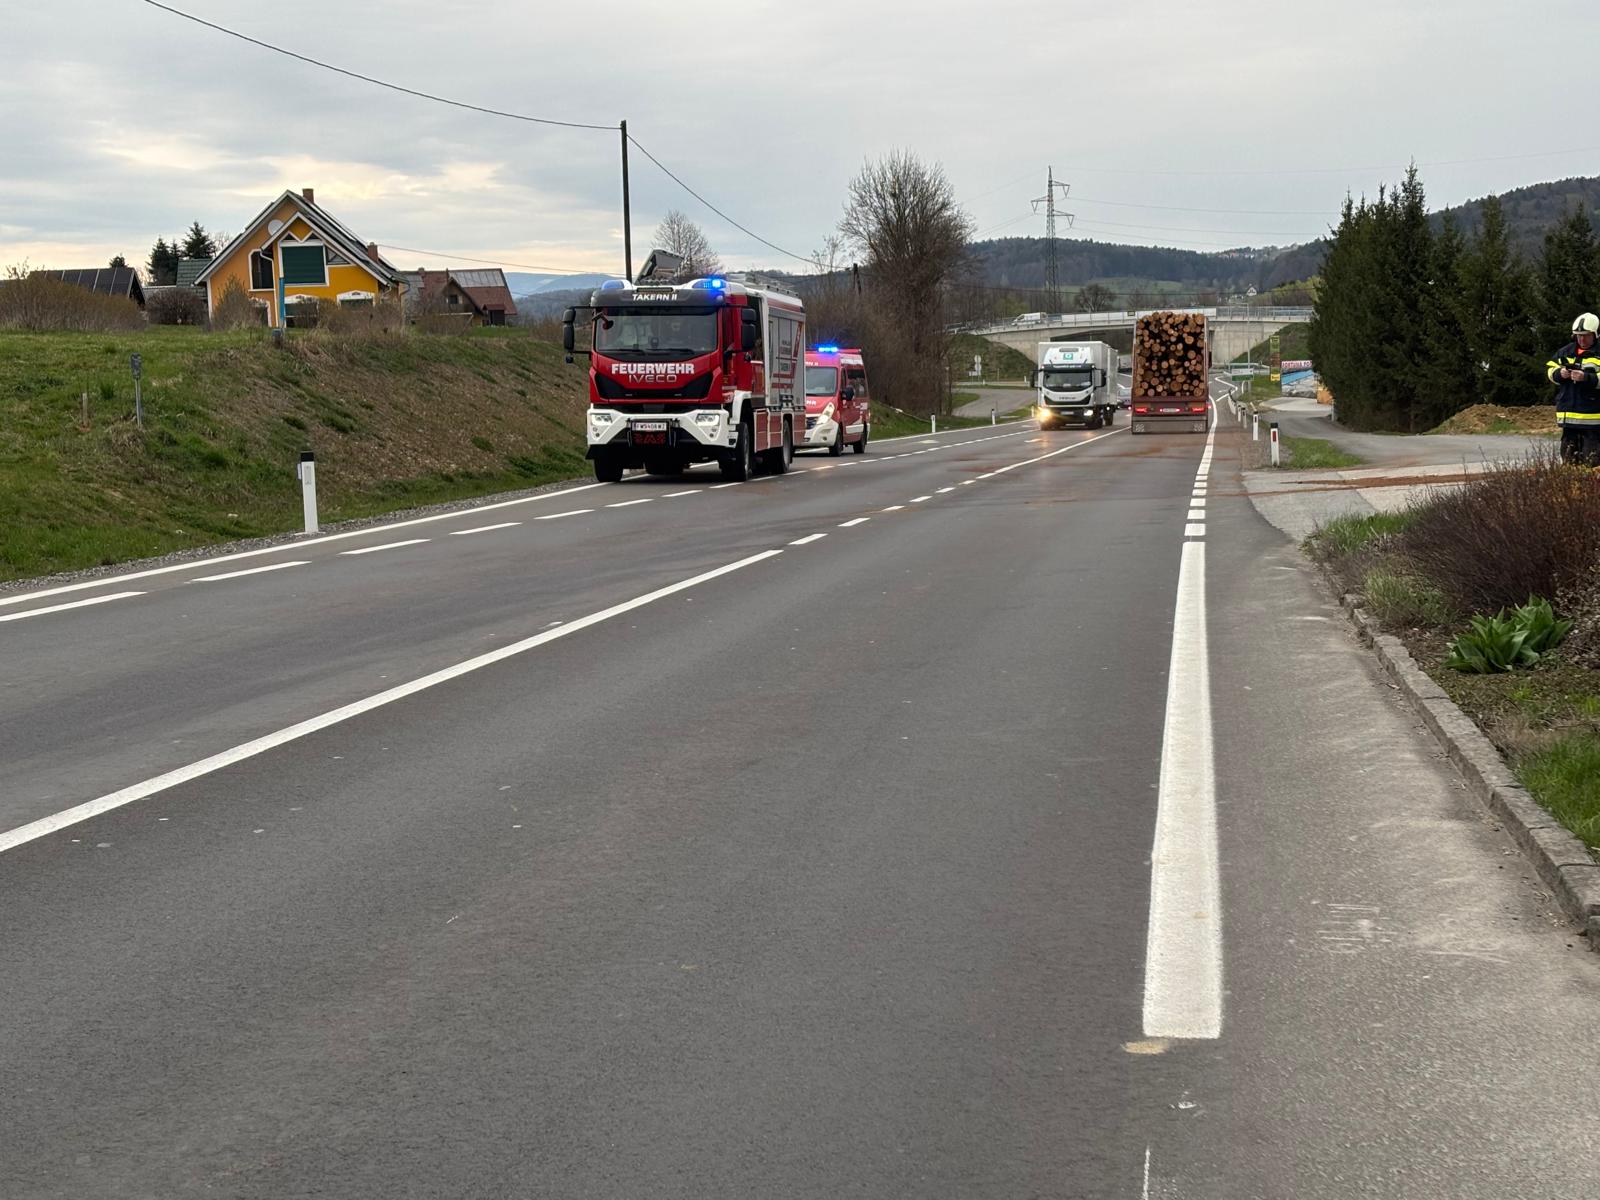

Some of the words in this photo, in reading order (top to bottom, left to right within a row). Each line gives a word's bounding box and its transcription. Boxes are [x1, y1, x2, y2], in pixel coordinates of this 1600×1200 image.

[632, 293, 670, 301] TAKERN
[611, 363, 695, 374] FEUERWEHR
[628, 374, 677, 383] IVECO
